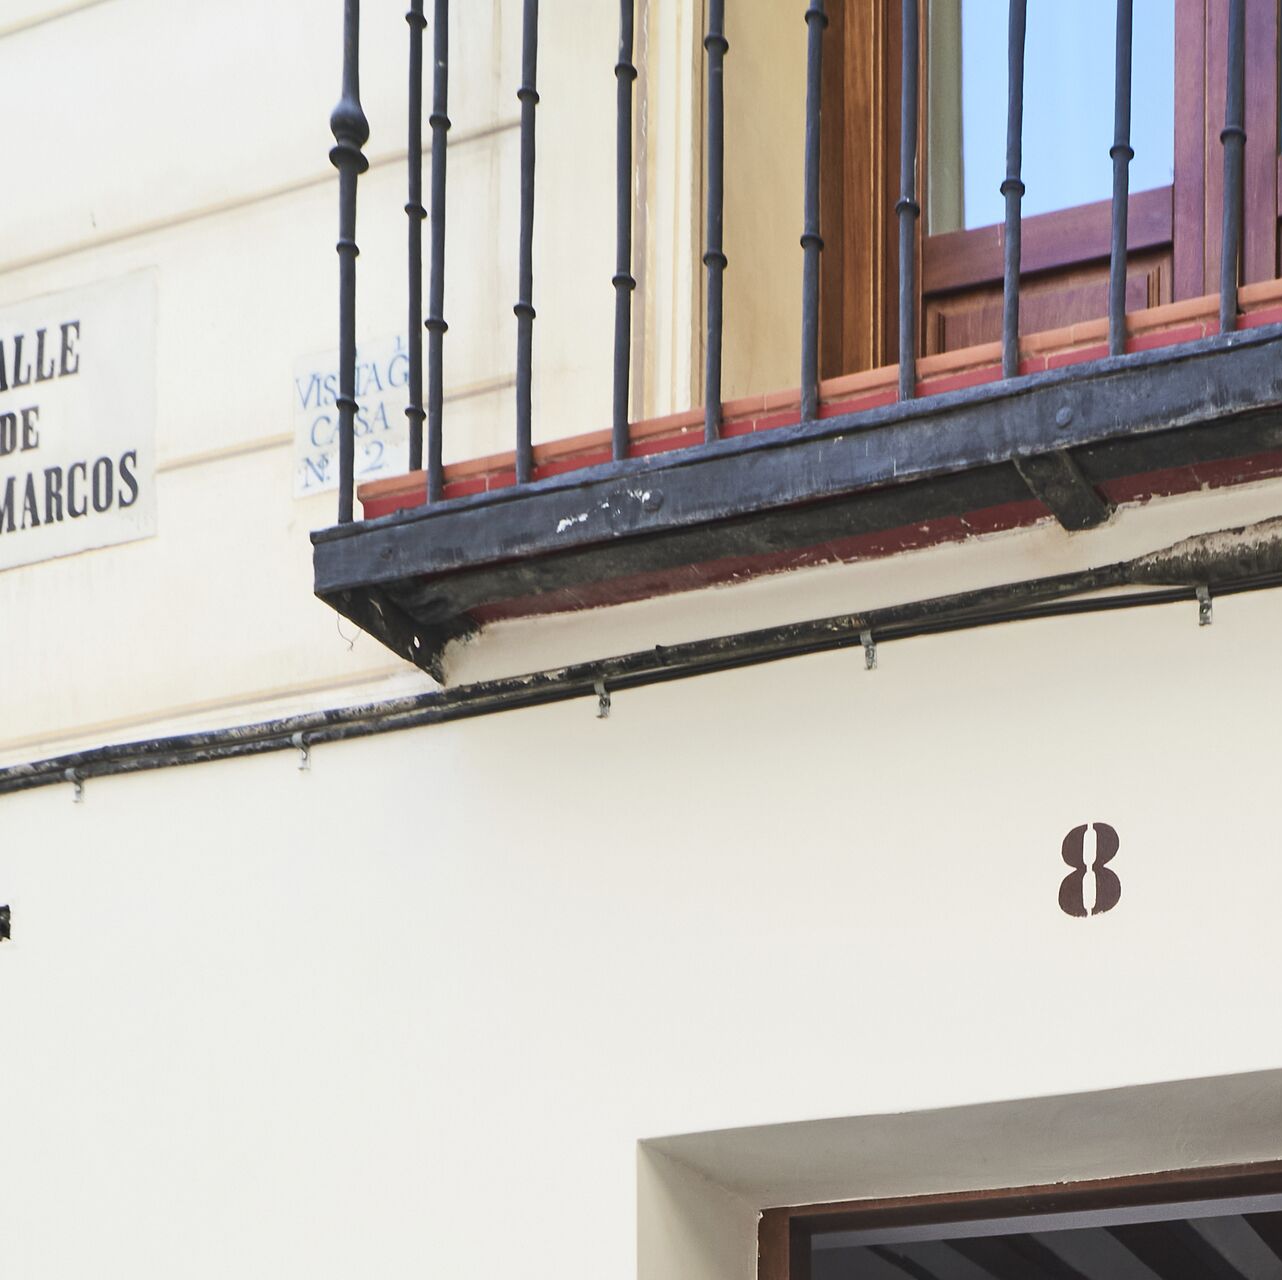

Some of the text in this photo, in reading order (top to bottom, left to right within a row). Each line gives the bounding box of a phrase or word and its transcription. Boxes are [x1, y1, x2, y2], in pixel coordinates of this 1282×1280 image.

[295, 362, 383, 411] VISTA
[0, 405, 40, 457] DE
[359, 439, 385, 475] 2
[1058, 821, 1122, 918] 8
